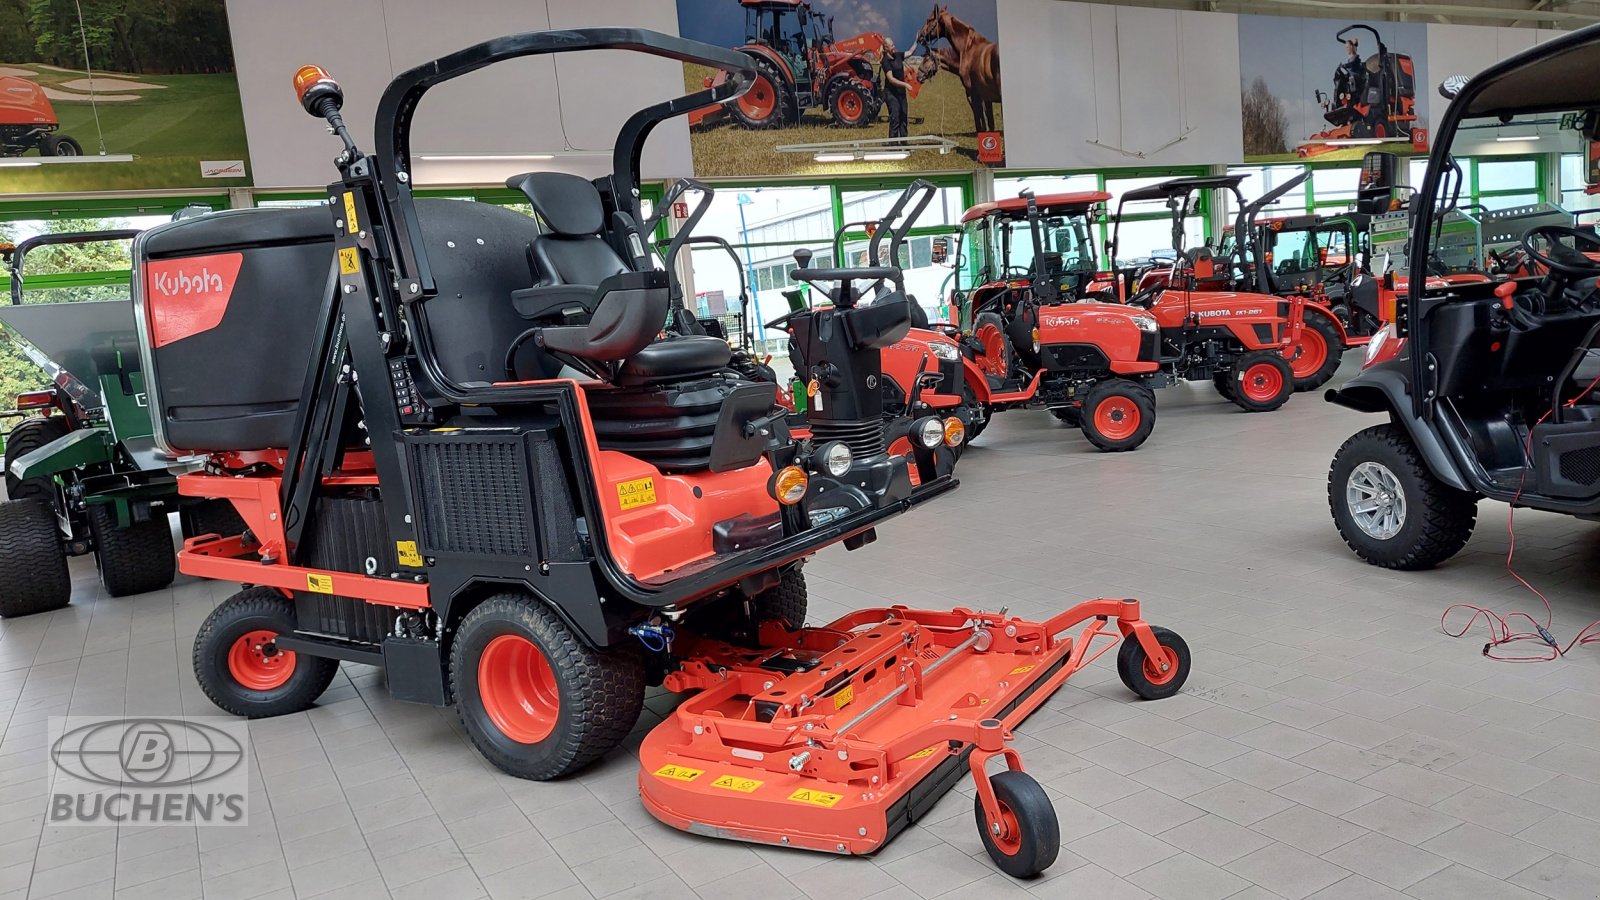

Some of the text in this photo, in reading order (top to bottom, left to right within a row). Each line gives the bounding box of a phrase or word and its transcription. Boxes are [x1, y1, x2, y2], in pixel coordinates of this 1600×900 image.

[154, 267, 223, 296] Kubota
[1198, 309, 1231, 318] KUBOTA
[1045, 317, 1080, 327] Kubota
